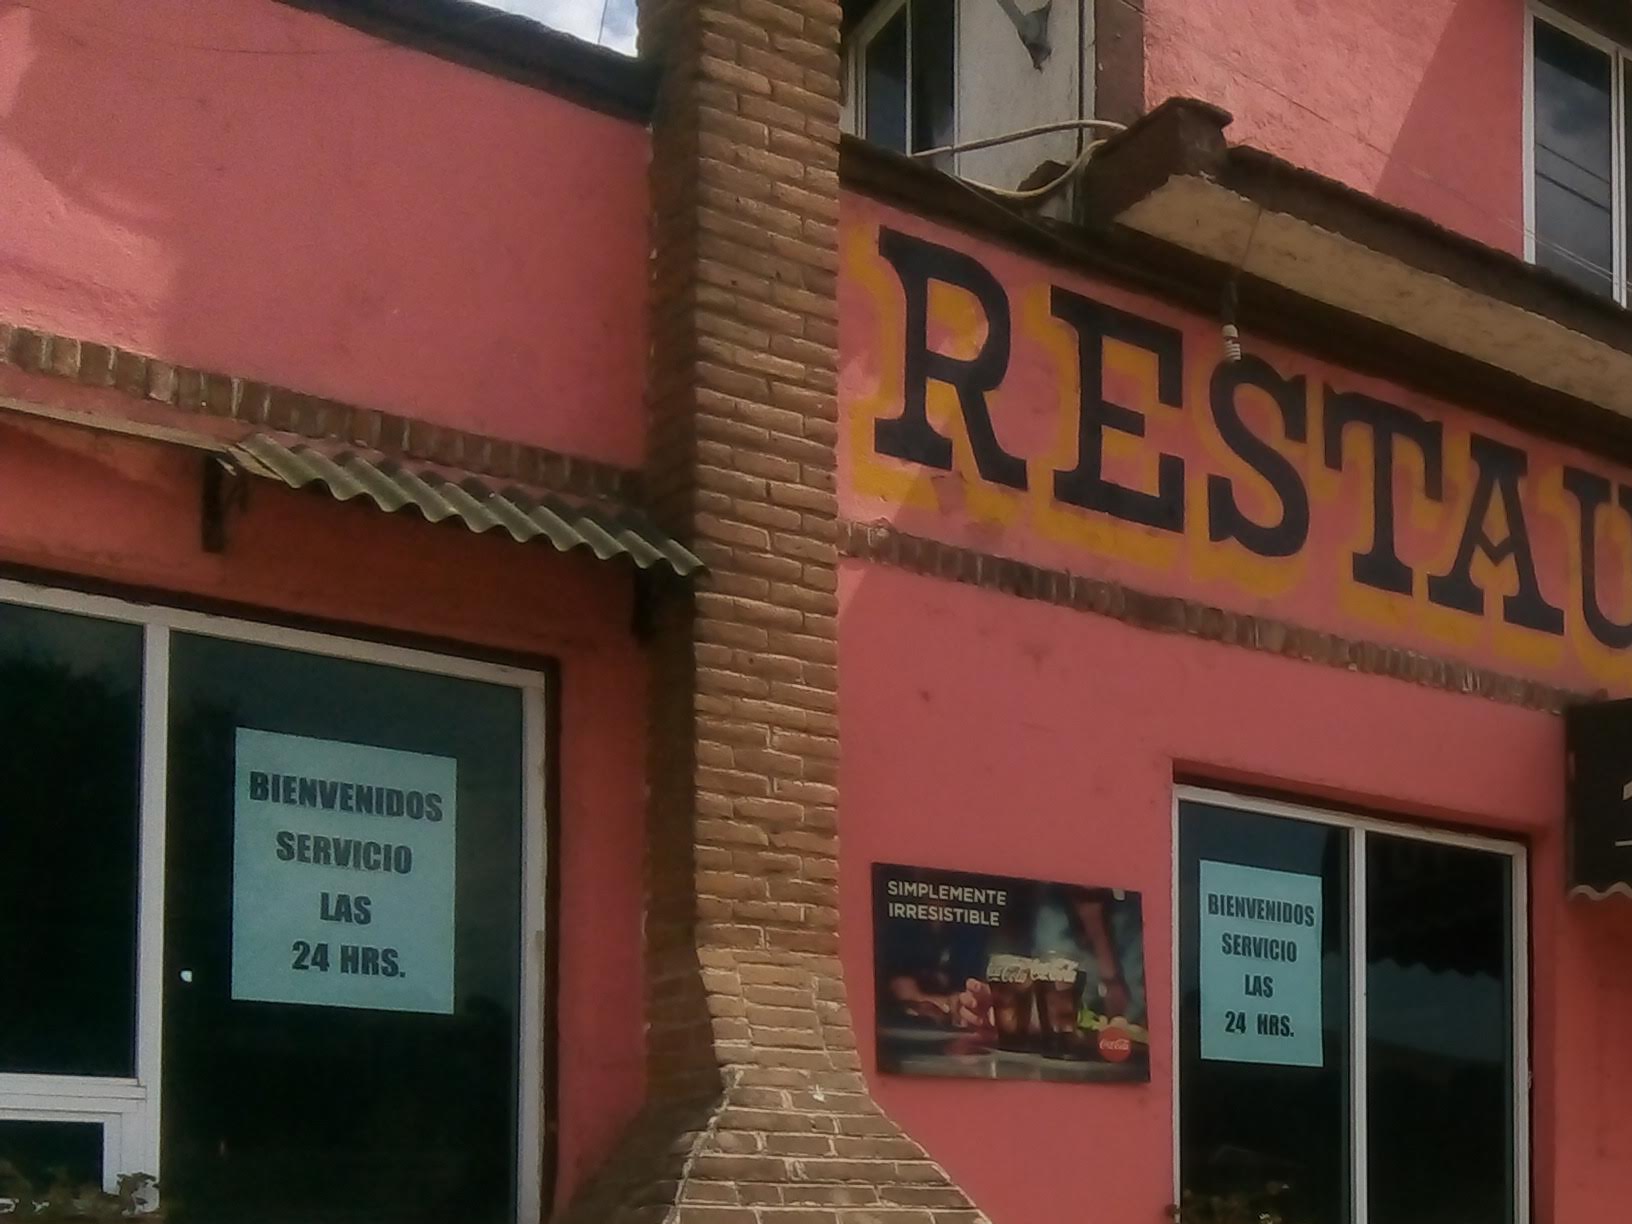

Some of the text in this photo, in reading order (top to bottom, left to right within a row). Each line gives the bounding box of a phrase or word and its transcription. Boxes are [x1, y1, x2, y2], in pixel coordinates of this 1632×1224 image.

[249, 771, 443, 822] BIENVENIDOS
[276, 831, 413, 874] SERVICIO
[320, 892, 372, 925] LAS
[887, 880, 1008, 906] SIMPLEMENTE
[888, 902, 1000, 927] IRRESISTIBLE
[1208, 893, 1315, 927] BIENVENIDOS
[291, 940, 406, 978] 24 HRS.
[1221, 932, 1298, 963] SERVICIO
[1245, 973, 1274, 998] LAS
[1225, 1010, 1295, 1038] 24 HRS.
